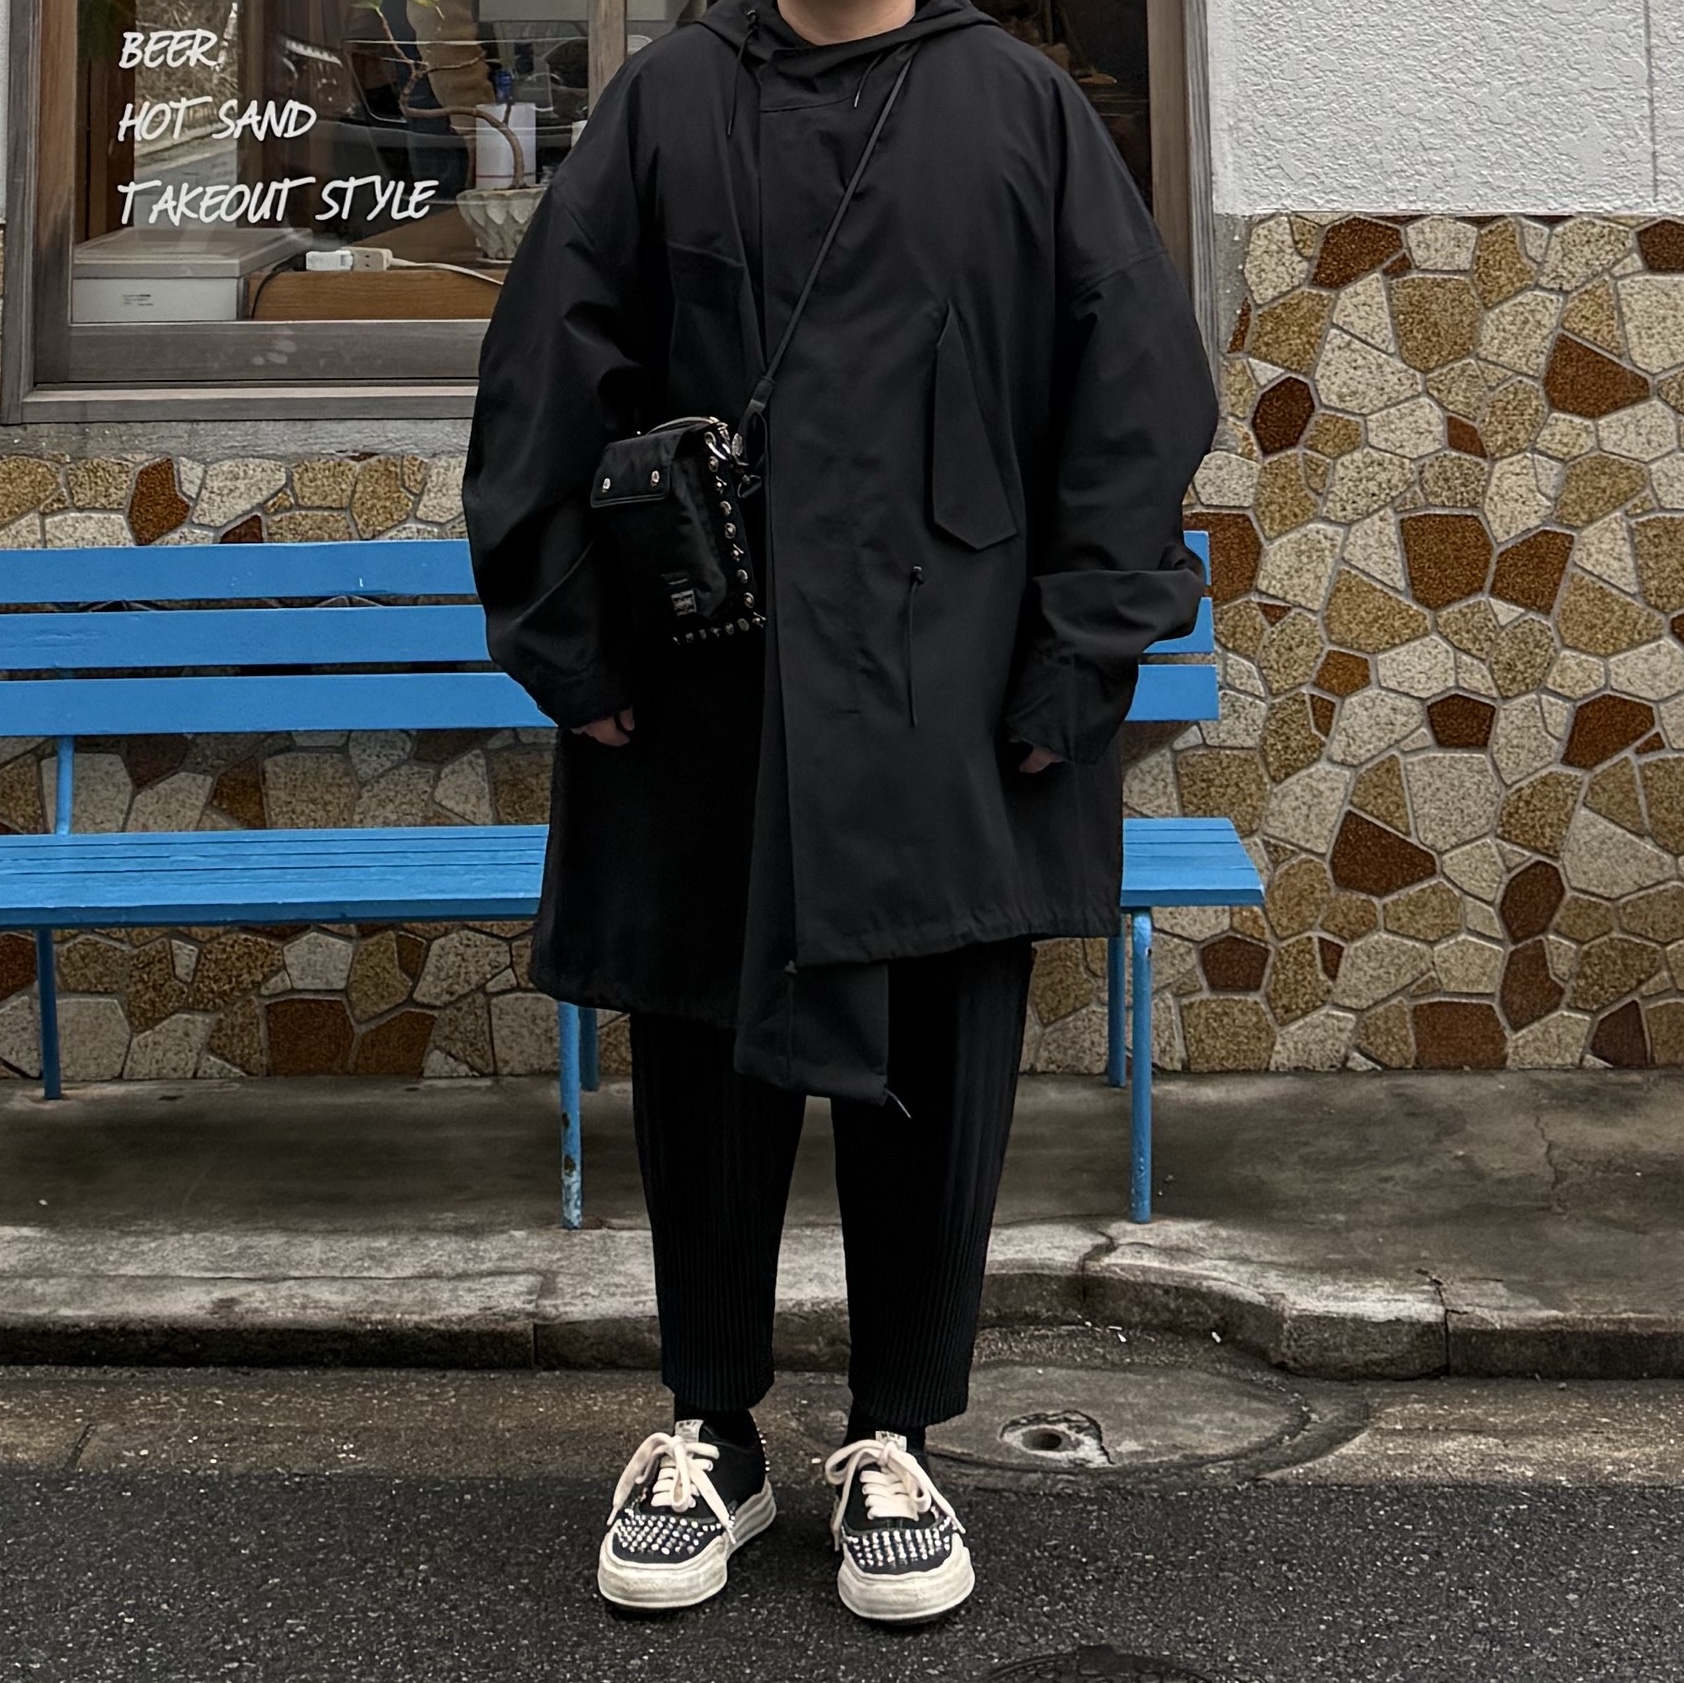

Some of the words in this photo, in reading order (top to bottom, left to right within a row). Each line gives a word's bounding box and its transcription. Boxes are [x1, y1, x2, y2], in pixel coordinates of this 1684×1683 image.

[118, 96, 213, 142] HOT
[212, 99, 317, 142] SAND
[117, 176, 316, 226] TAKEOUT
[315, 175, 440, 221] STYLE
